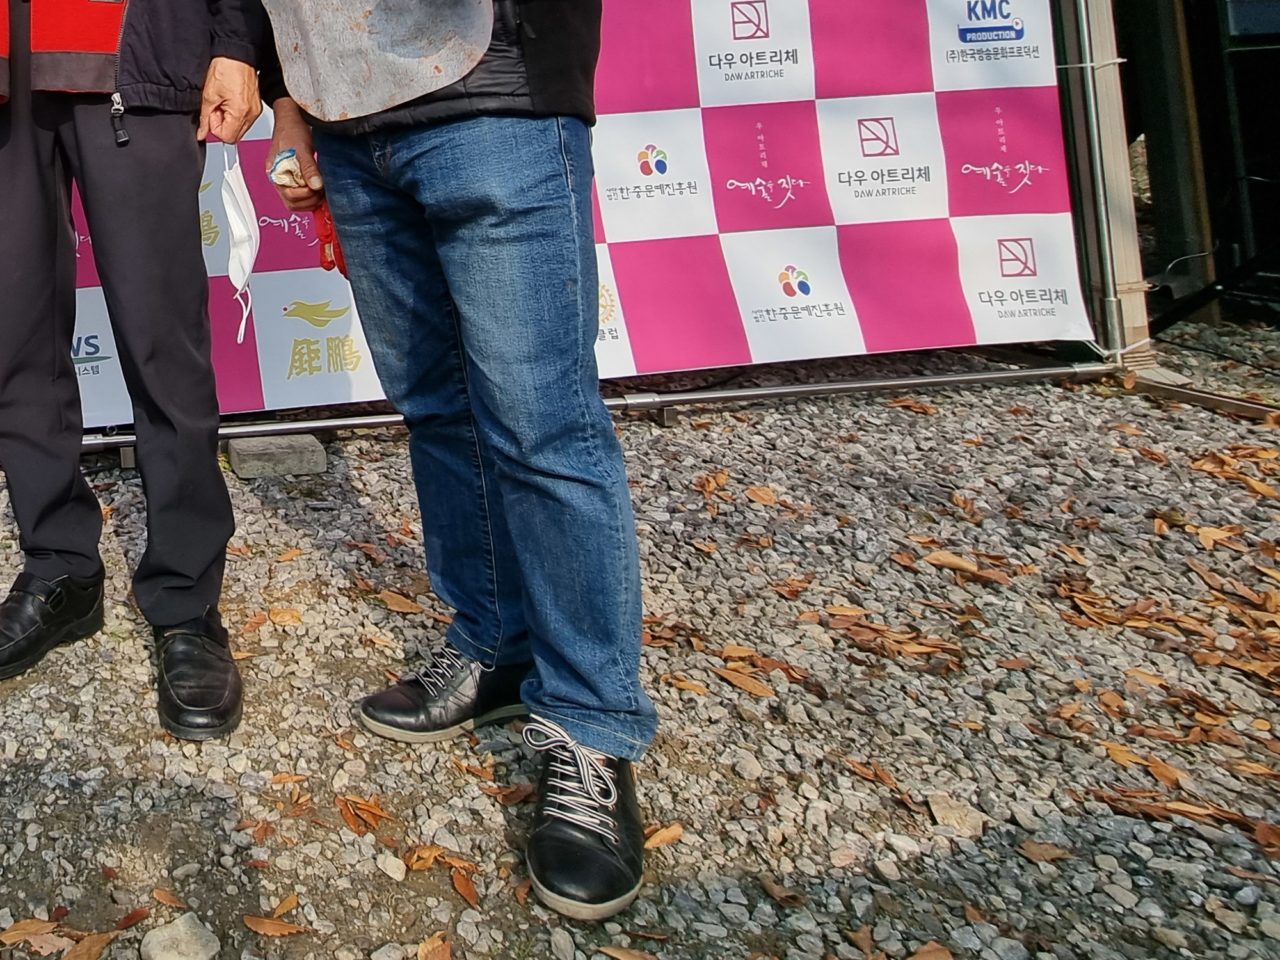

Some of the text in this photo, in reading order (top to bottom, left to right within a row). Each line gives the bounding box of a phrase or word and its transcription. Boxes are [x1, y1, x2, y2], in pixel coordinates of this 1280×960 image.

[967, 0, 1011, 21] KMC
[967, 30, 1015, 39] PRODUCTION
[946, 46, 1039, 64] (주)한국방송문화프로덕션
